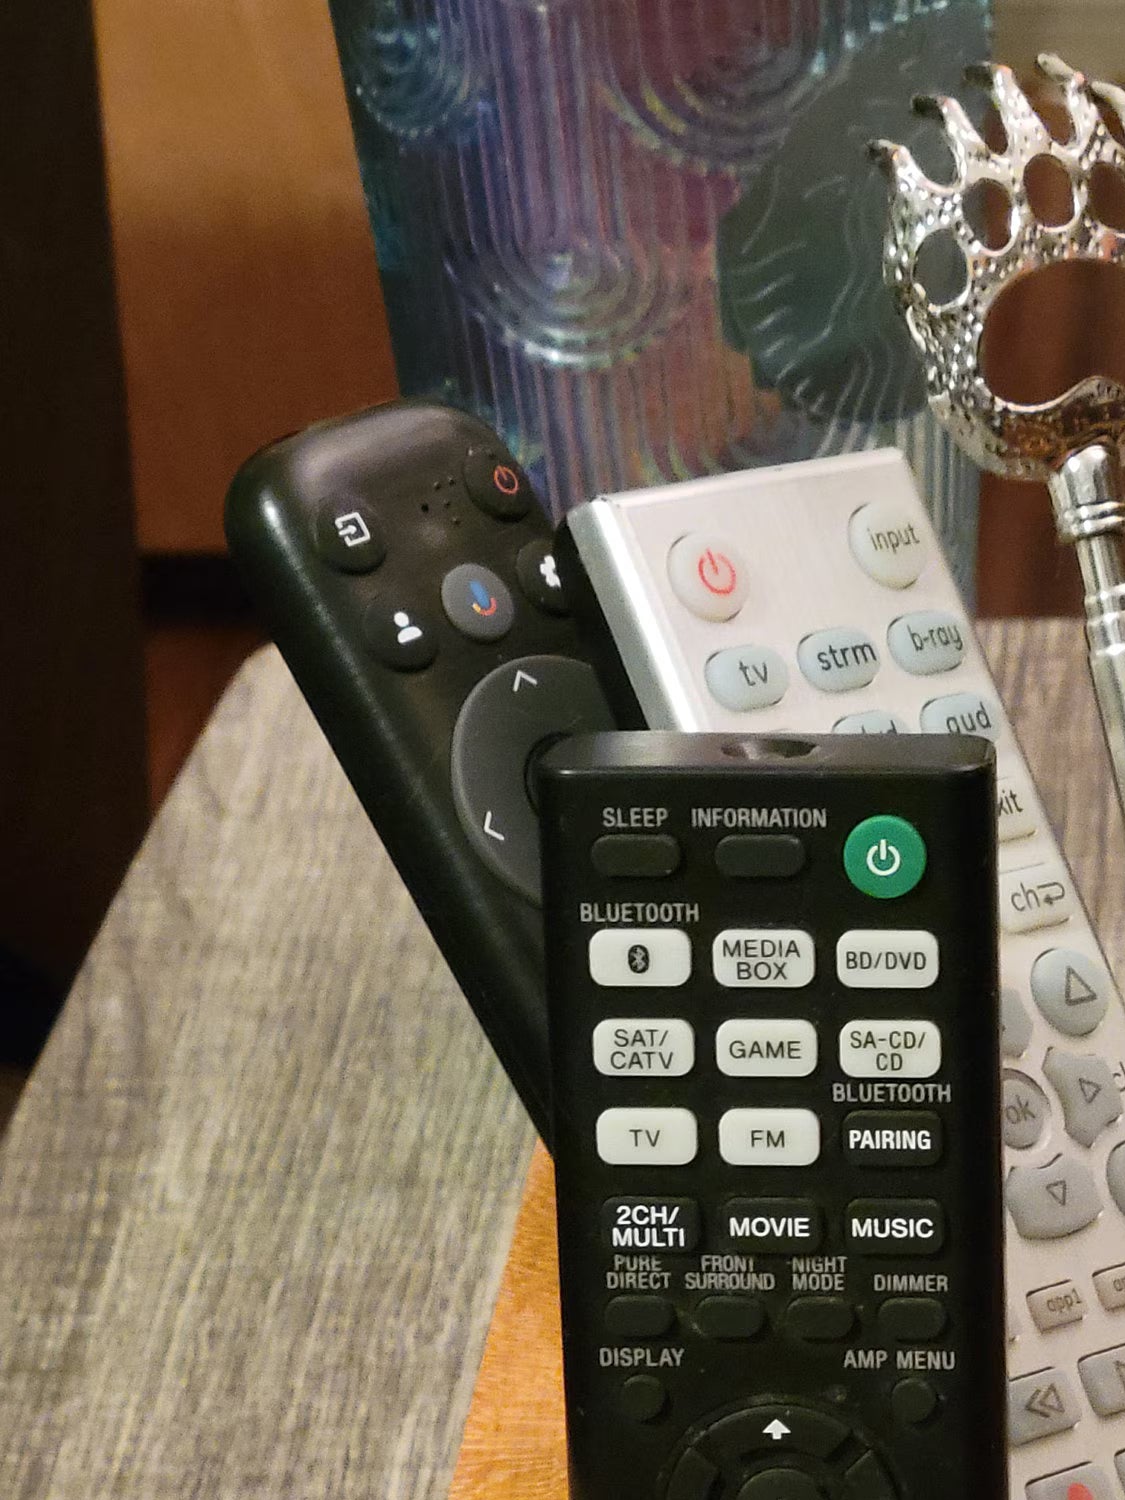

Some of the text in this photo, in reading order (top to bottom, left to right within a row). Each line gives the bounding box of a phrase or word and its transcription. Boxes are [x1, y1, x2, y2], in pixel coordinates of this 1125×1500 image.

[867, 523, 921, 554] input
[907, 624, 964, 652] b-ray
[816, 640, 877, 671] strm
[738, 660, 769, 688] tv
[998, 789, 1024, 817] xit
[602, 808, 669, 827] SLEEP
[691, 808, 828, 828] INFORMATION
[1011, 882, 1041, 912] ch
[580, 903, 700, 923] BLUETOOTH
[722, 939, 801, 958] MEDIA
[845, 951, 928, 971] BD/DVD
[736, 962, 788, 981] BOX
[613, 1029, 669, 1048] SAT/
[850, 1031, 926, 1051] SA-CD/
[729, 1040, 801, 1060] GAME
[610, 1051, 674, 1070] CATV
[876, 1053, 904, 1072] CD
[832, 1084, 951, 1104] BLUETOOTH
[1005, 1095, 1037, 1124] ok
[629, 1129, 661, 1148] TV
[750, 1130, 786, 1149] FM
[849, 1129, 932, 1150] PAIRING
[616, 1206, 680, 1225] 2CH/
[729, 1217, 811, 1237] MOVIE
[851, 1218, 935, 1239] MUSIC
[612, 1228, 685, 1247] MULTI
[614, 1254, 663, 1272] PURE
[700, 1254, 754, 1273] FRONT
[792, 1256, 848, 1273] NIGHT
[606, 1272, 672, 1290] DIRECT
[685, 1273, 776, 1290] SURROUND
[792, 1274, 845, 1291] MODE
[874, 1275, 949, 1293] DIMMER
[599, 1347, 685, 1368] DISPLAY
[844, 1350, 956, 1370] AMP MENU
